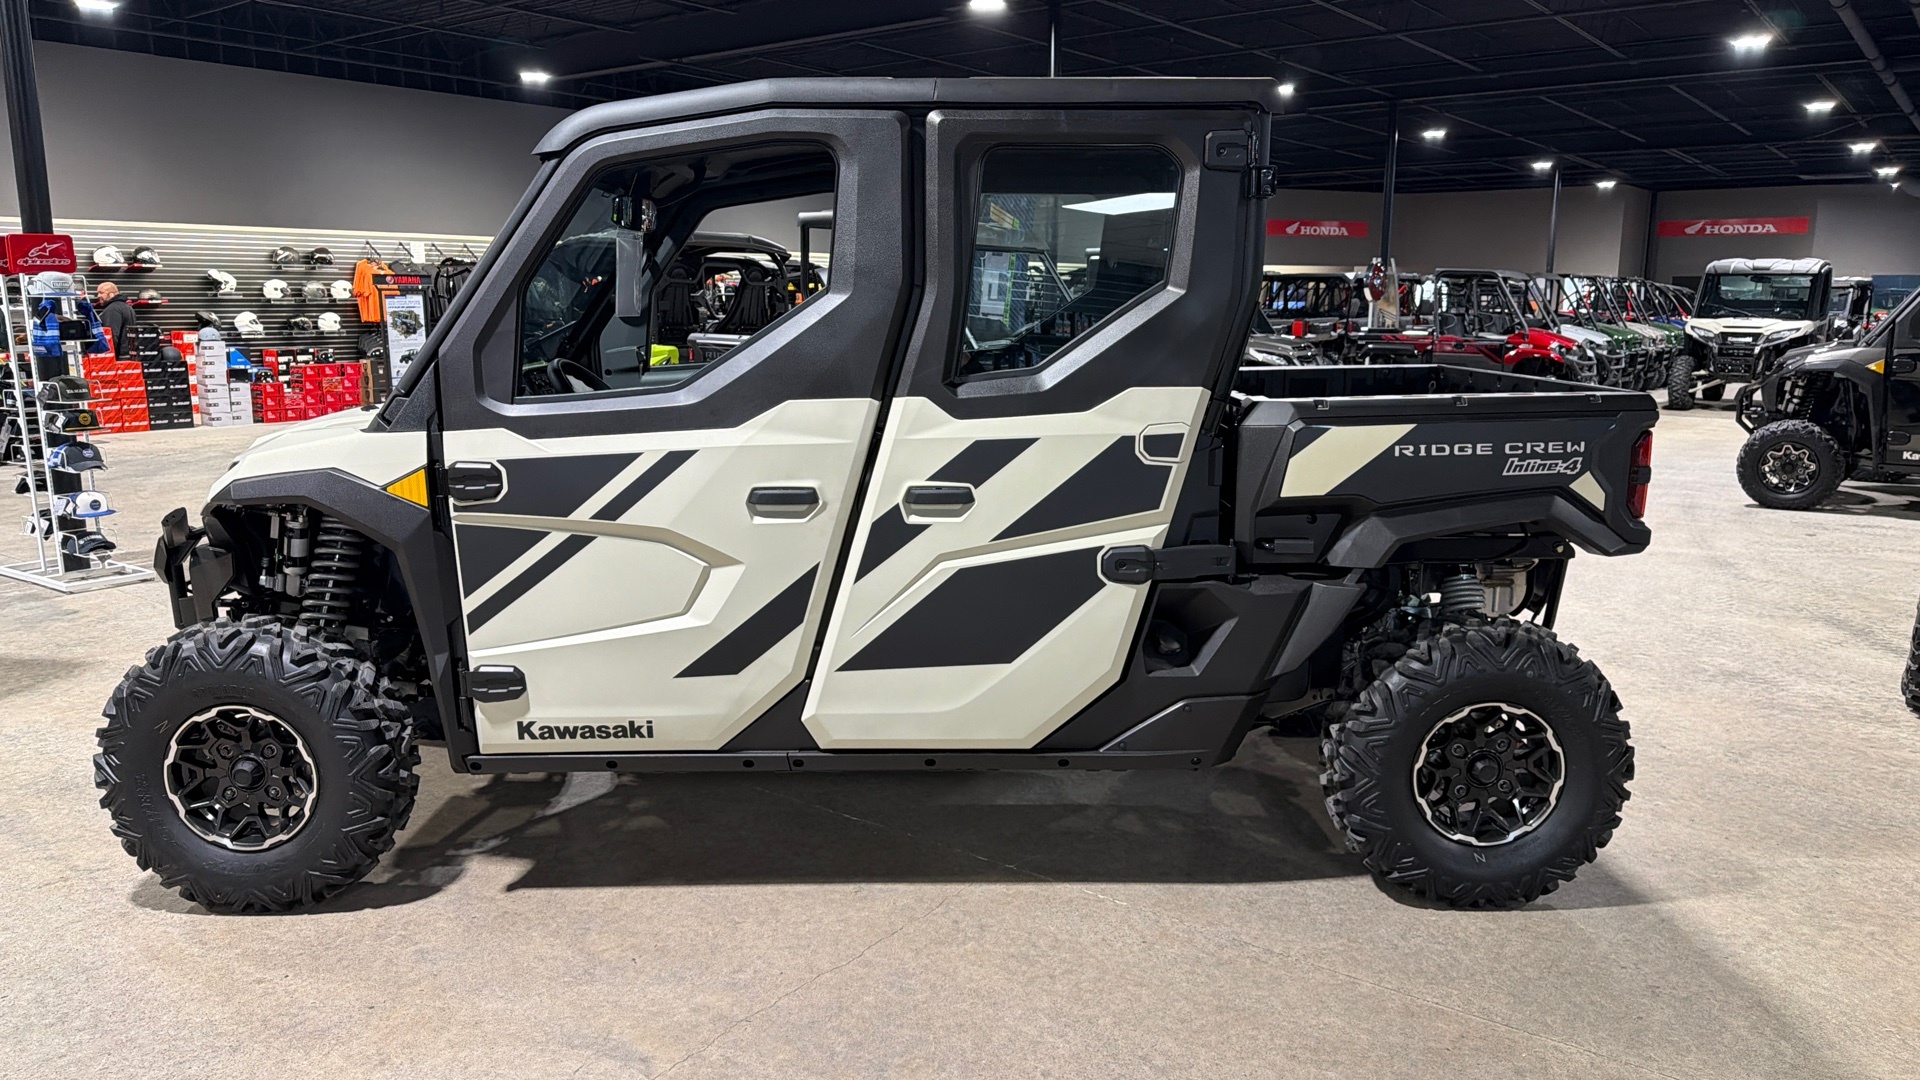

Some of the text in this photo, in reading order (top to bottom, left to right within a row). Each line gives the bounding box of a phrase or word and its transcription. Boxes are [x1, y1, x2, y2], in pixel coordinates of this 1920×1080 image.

[1300, 226, 1349, 236] HONDA
[1704, 224, 1777, 235] HONDA
[393, 275, 421, 284] YAMAHA
[1394, 441, 1586, 457] RIDGE CREW
[1501, 457, 1584, 476] Inline-4
[516, 720, 654, 740] Kawasaki
